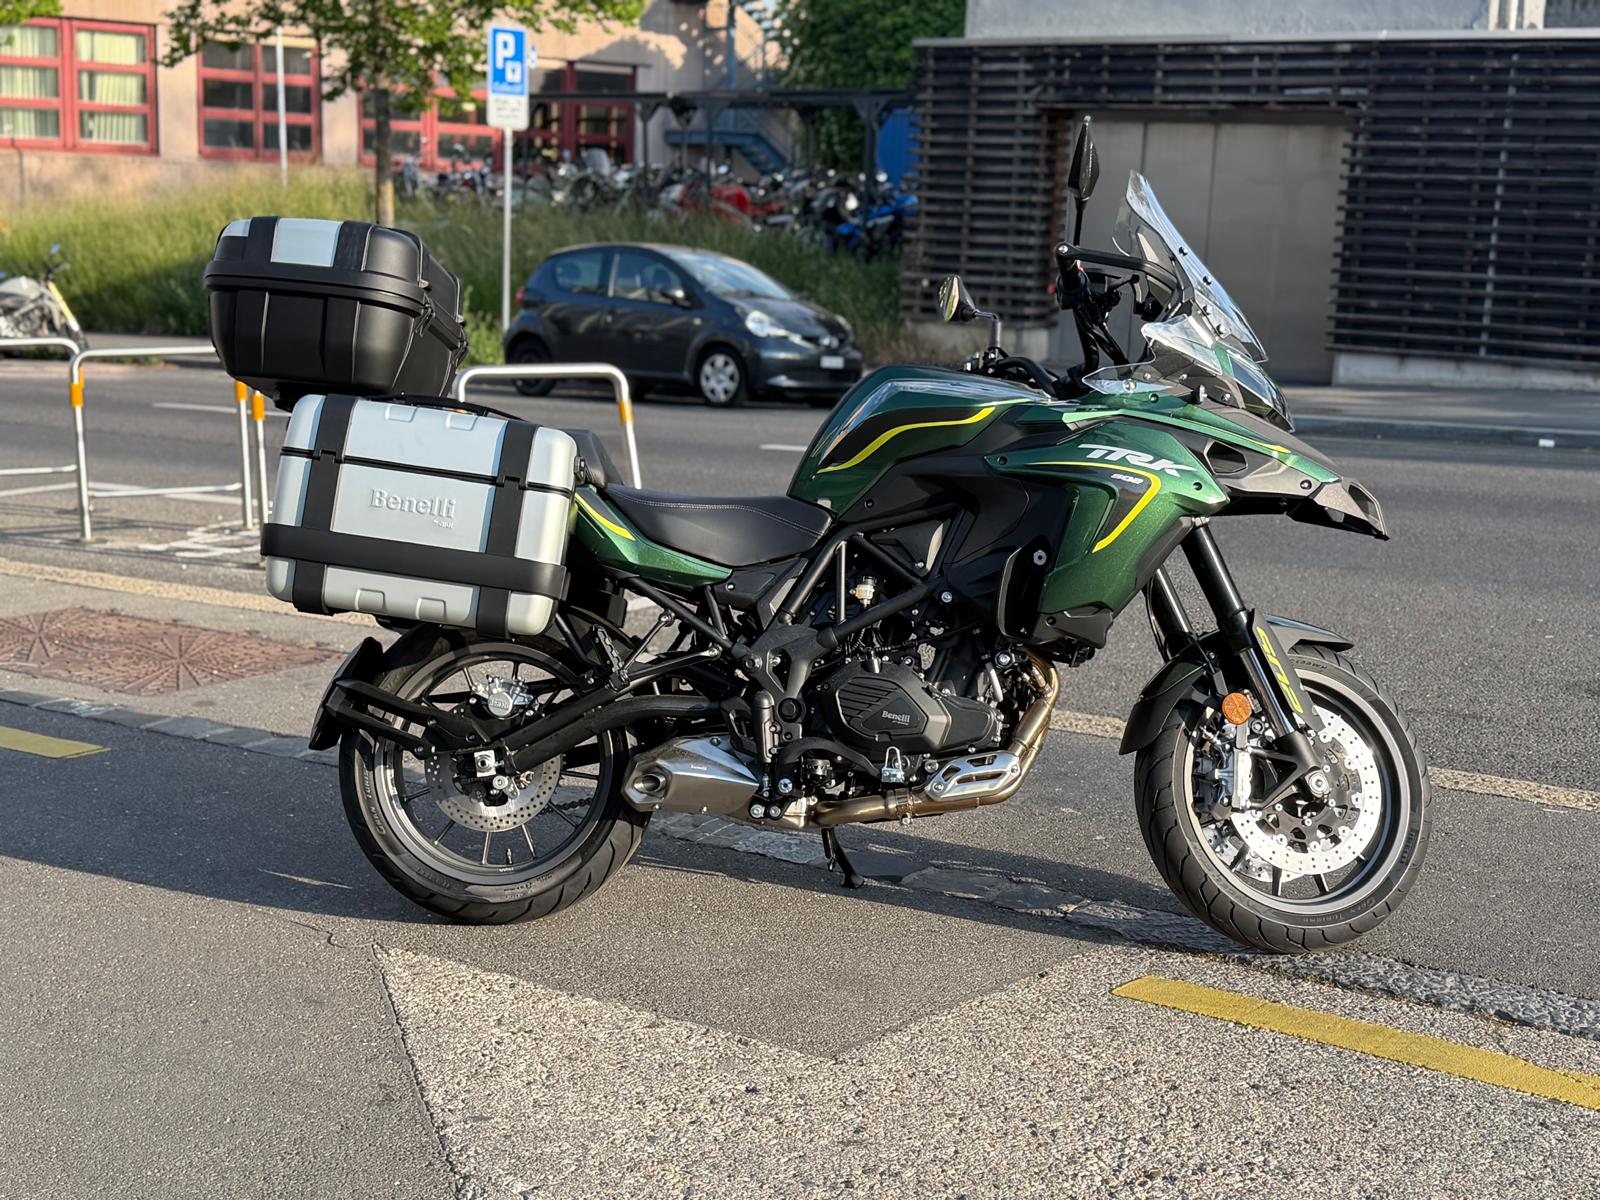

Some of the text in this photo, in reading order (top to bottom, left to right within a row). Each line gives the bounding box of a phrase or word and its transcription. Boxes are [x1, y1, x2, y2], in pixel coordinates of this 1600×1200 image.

[496, 31, 516, 70] P
[1078, 444, 1197, 478] TRK
[369, 488, 456, 519] Benelli
[881, 710, 911, 723] Benelli
